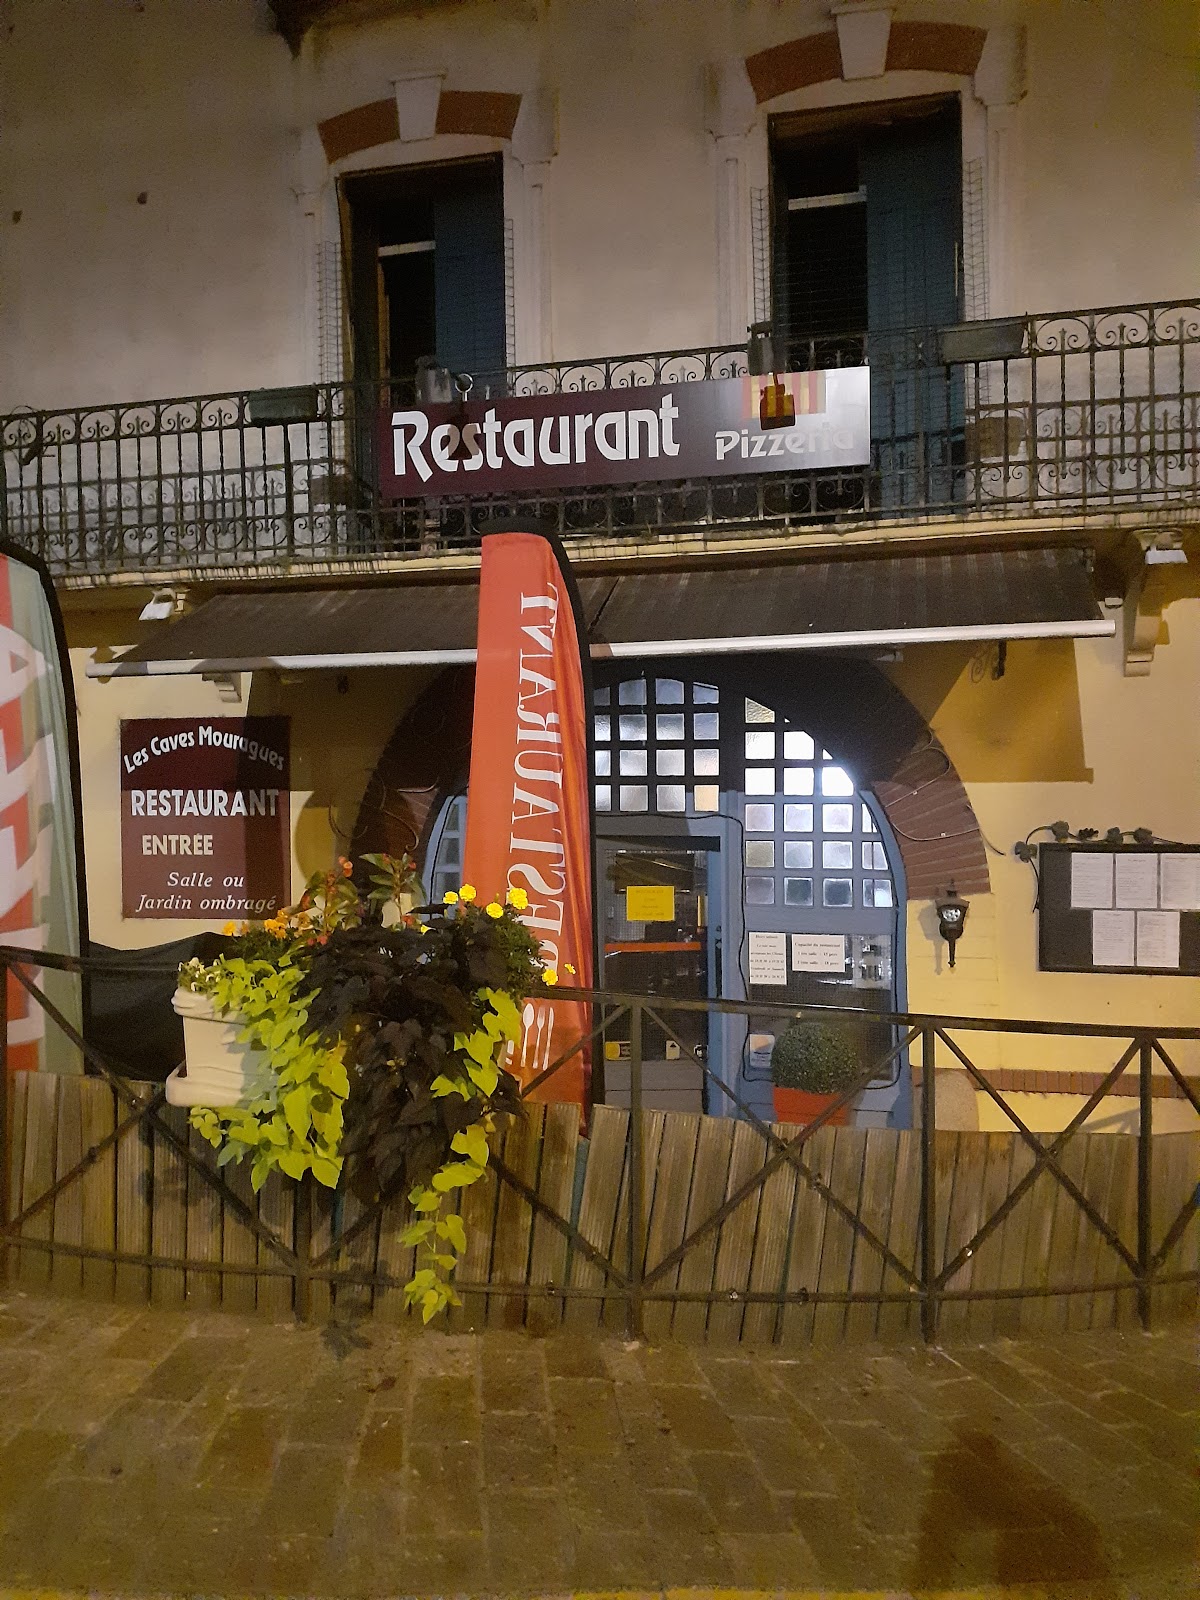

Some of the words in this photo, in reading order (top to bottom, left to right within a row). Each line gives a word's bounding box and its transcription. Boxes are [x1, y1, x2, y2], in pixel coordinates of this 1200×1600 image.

[391, 393, 680, 482] Restaurant
[715, 421, 856, 461] Pizzeria
[123, 747, 150, 774] Les
[150, 730, 196, 757] Caves
[198, 725, 286, 771] Mouragues
[131, 789, 279, 817] RESTAURANT
[167, 871, 213, 887] Salle
[223, 876, 245, 887] ou
[136, 894, 192, 913] Jardin
[200, 894, 277, 914] ombragé
